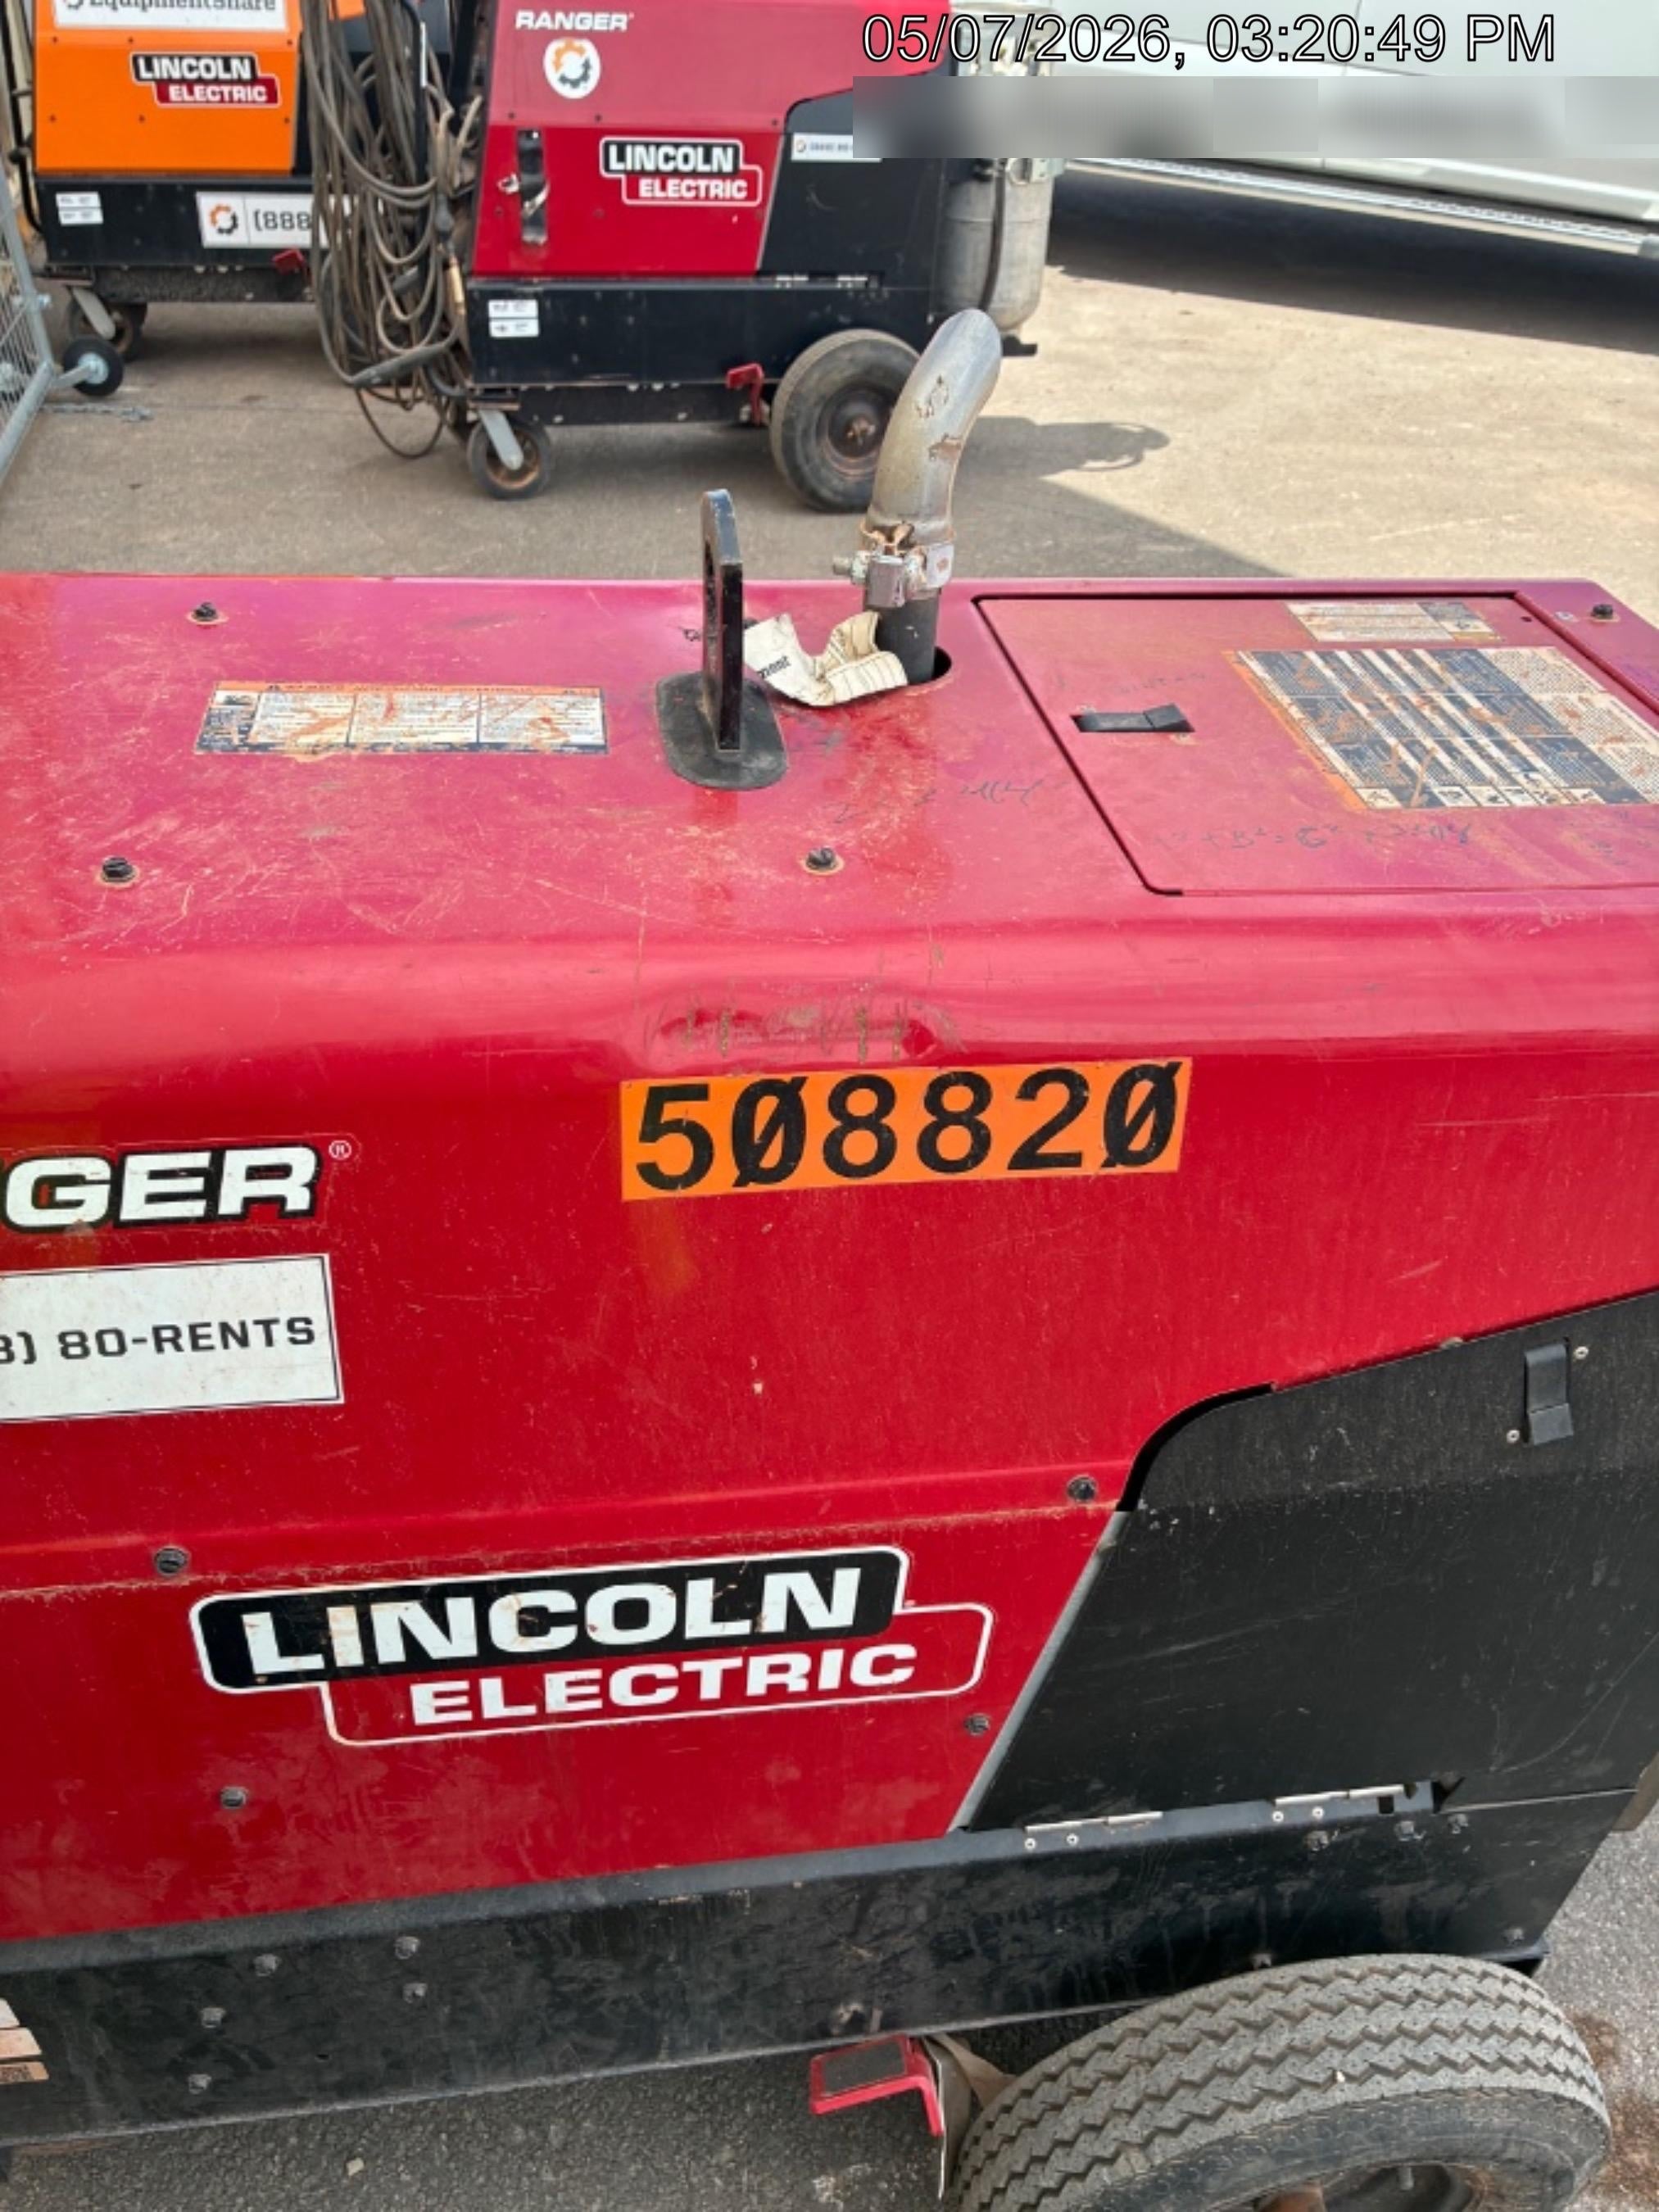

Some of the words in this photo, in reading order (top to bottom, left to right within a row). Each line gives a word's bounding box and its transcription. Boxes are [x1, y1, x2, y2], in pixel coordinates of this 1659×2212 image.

[515, 10, 628, 32] RANGER
[138, 56, 252, 80] LINCOLN
[168, 84, 268, 102] ELECTRIC
[609, 143, 734, 173] LINCOLN
[638, 178, 748, 199] ELECTRIC
[57, 1317, 316, 1360] 80-RENTS
[243, 1566, 862, 1675] LINCOLN
[411, 1643, 916, 1725] ELECTRIC
